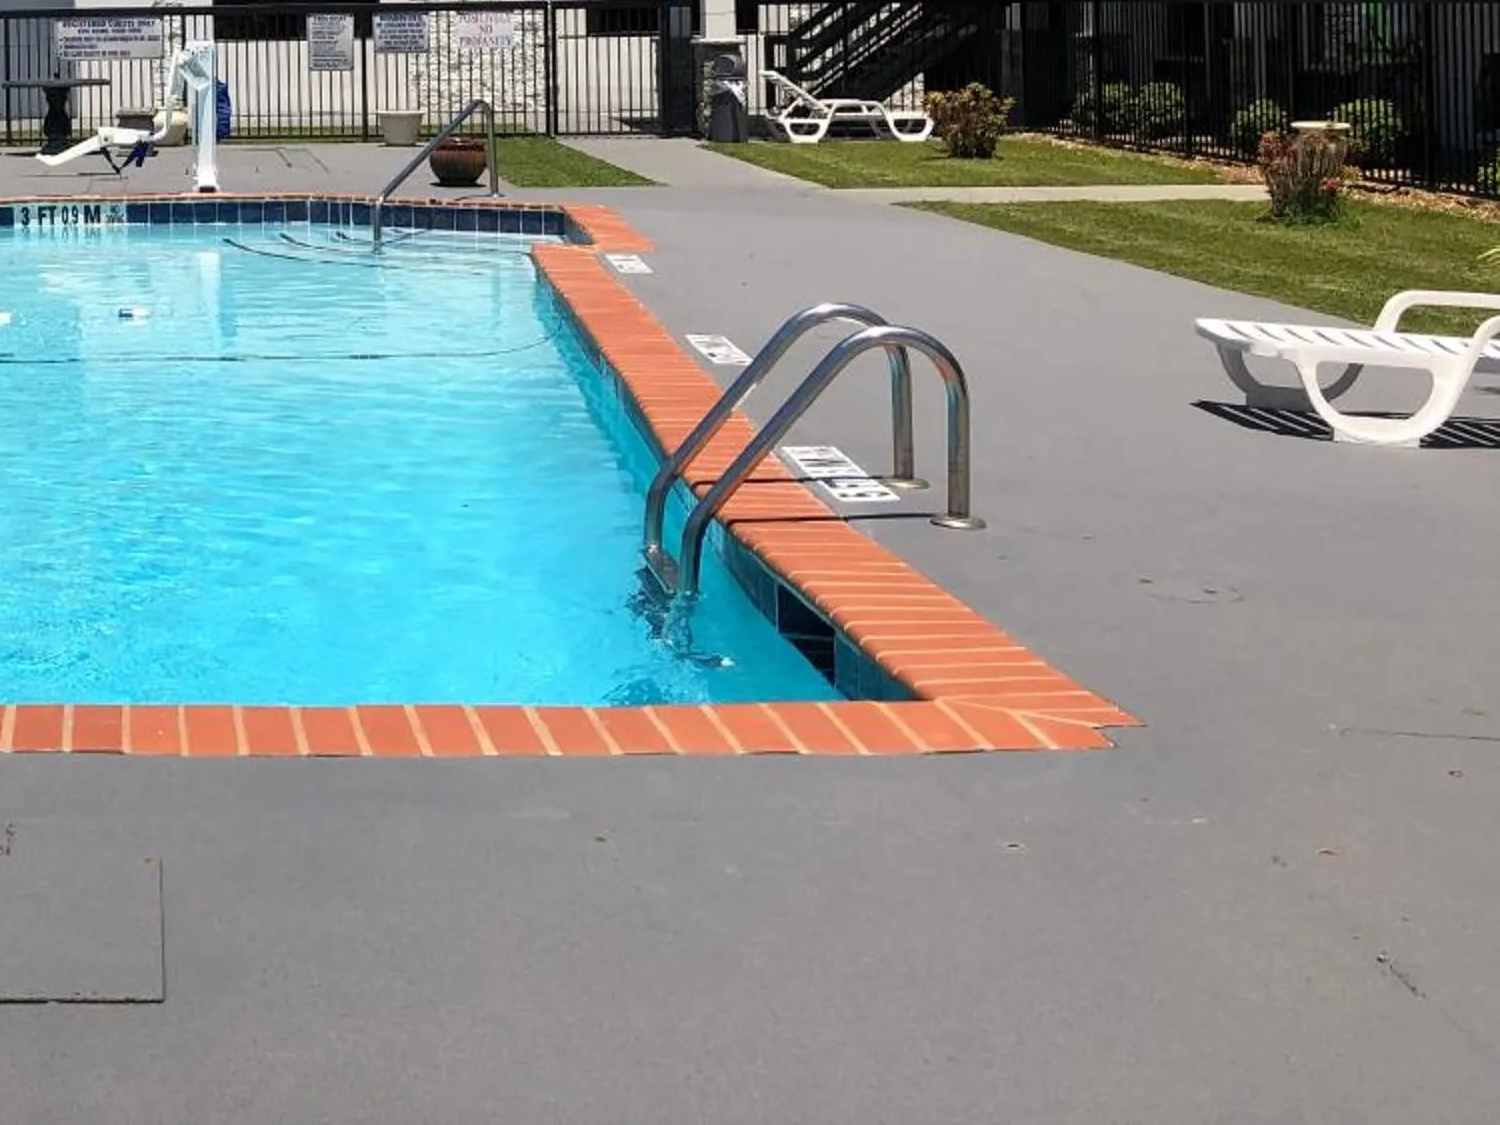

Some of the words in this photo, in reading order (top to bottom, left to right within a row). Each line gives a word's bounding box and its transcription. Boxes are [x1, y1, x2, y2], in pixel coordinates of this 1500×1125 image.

[21, 207, 30, 226] 3
[38, 206, 57, 225] FT
[84, 205, 101, 224] M
